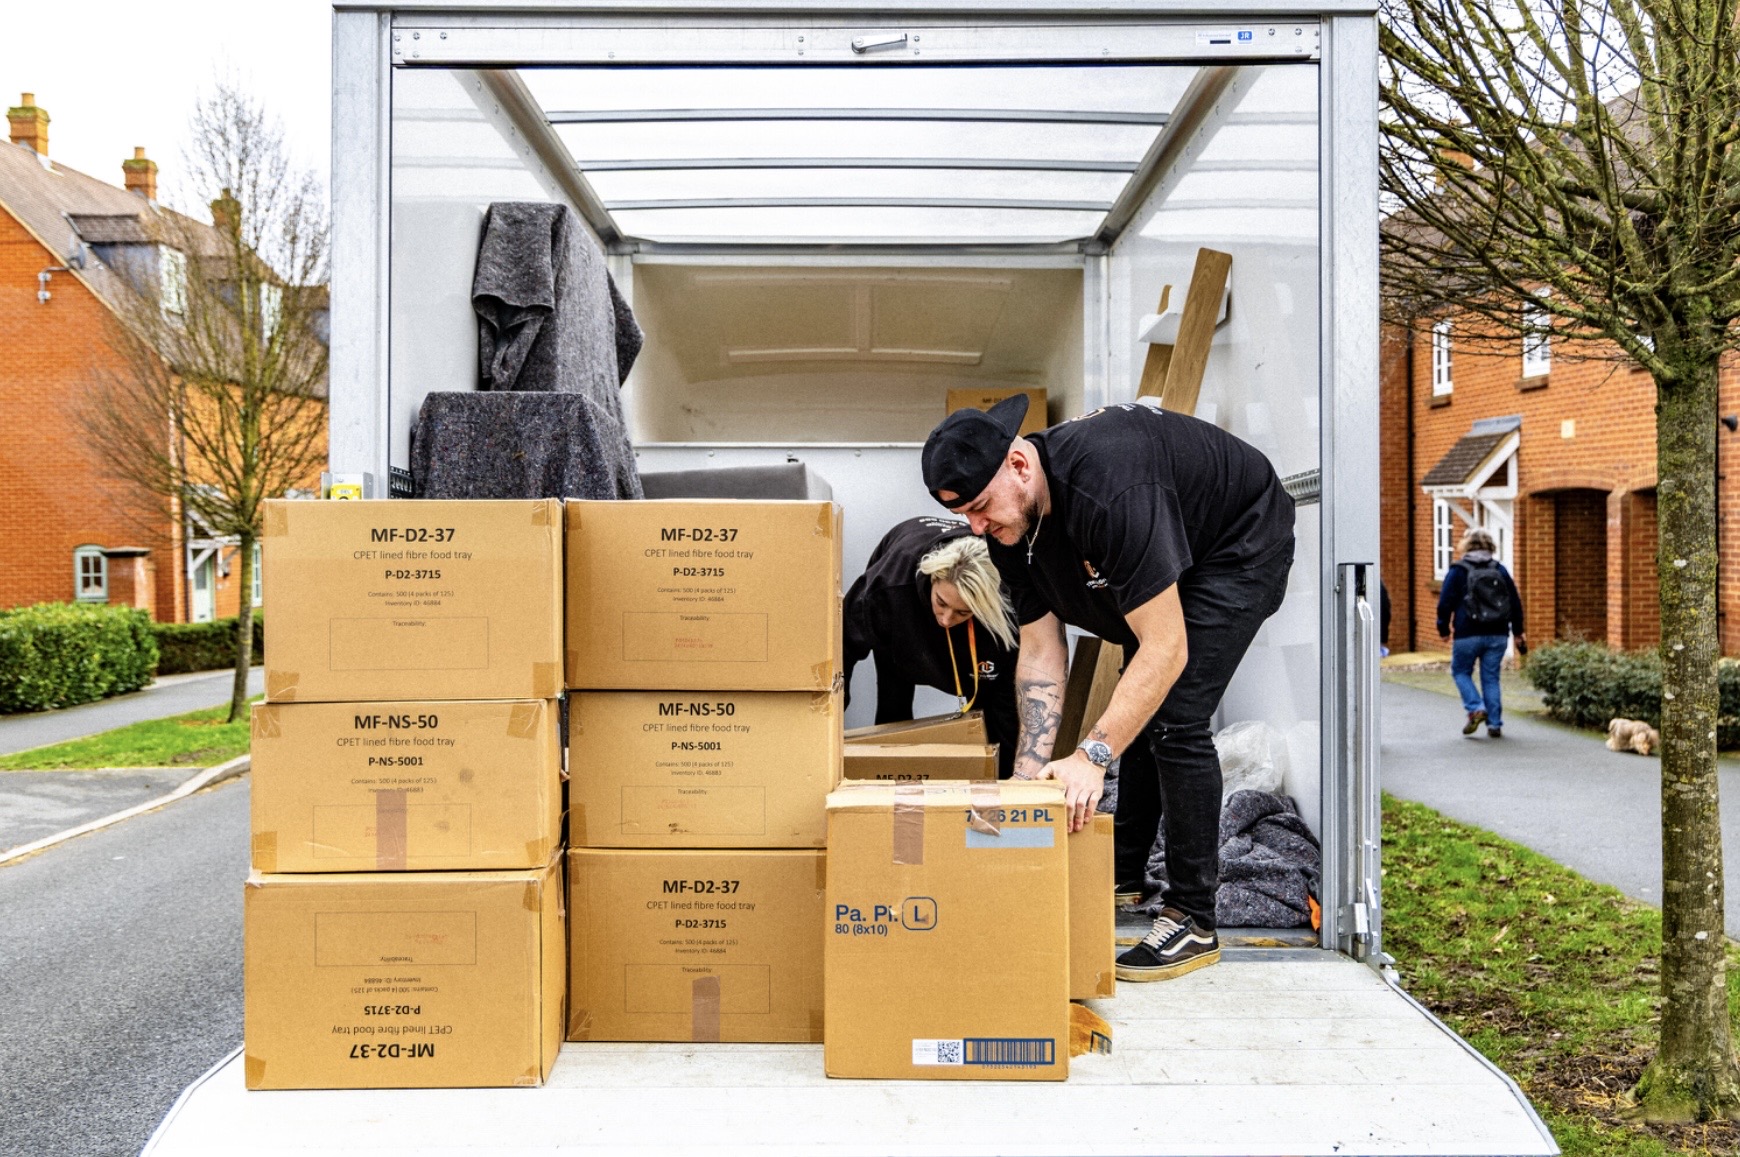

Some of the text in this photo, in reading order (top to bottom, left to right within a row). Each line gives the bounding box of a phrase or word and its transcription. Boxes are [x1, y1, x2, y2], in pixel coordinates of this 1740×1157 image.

[371, 527, 456, 543] MF-D2-37
[661, 527, 739, 543] MF-D2-37
[353, 549, 473, 562] CPET lined fibre food tray
[643, 548, 754, 560] CPET lined fibre food tray
[385, 569, 442, 580] P-D2-3715
[672, 567, 725, 578] P-D2-3715
[396, 590, 408, 598] 500
[416, 590, 432, 598] packs
[432, 590, 439, 598] of
[682, 586, 694, 594] 500
[700, 586, 716, 594] packs
[716, 586, 722, 594] of
[385, 600, 412, 608] Inventory
[658, 702, 735, 717] MF-NS-50
[354, 714, 439, 730] MF-NS-50
[642, 723, 751, 734] CPET lined fibre food tray
[336, 736, 456, 748] CPET lined fibre food tray
[671, 741, 722, 751] P-NS-5001
[368, 756, 424, 767] P-NS-5001
[680, 760, 692, 768] 500
[698, 760, 713, 768] packs
[714, 760, 720, 768] of
[378, 777, 390, 786] 500
[398, 777, 414, 786] packs
[415, 777, 422, 786] of
[1010, 809, 1027, 823] 21
[1034, 809, 1054, 823] PL
[662, 879, 740, 894] MF-D2-37
[646, 900, 756, 912] CPET lined fibre food tray
[836, 905, 927, 923] Pa. Pi. L
[675, 919, 727, 929] P-D2-3715
[835, 924, 887, 936] 80 (8x10)
[684, 938, 695, 946] 500
[702, 938, 718, 946] packs
[718, 938, 724, 946] of
[394, 976, 421, 984] Inventory
[366, 986, 373, 994] of
[374, 986, 390, 994] packs
[398, 986, 410, 994] 500
[363, 1005, 421, 1016] P-D2-3715
[331, 1024, 453, 1036] CPET lined fibre food tray
[349, 1043, 435, 1059] MF-D2-37
